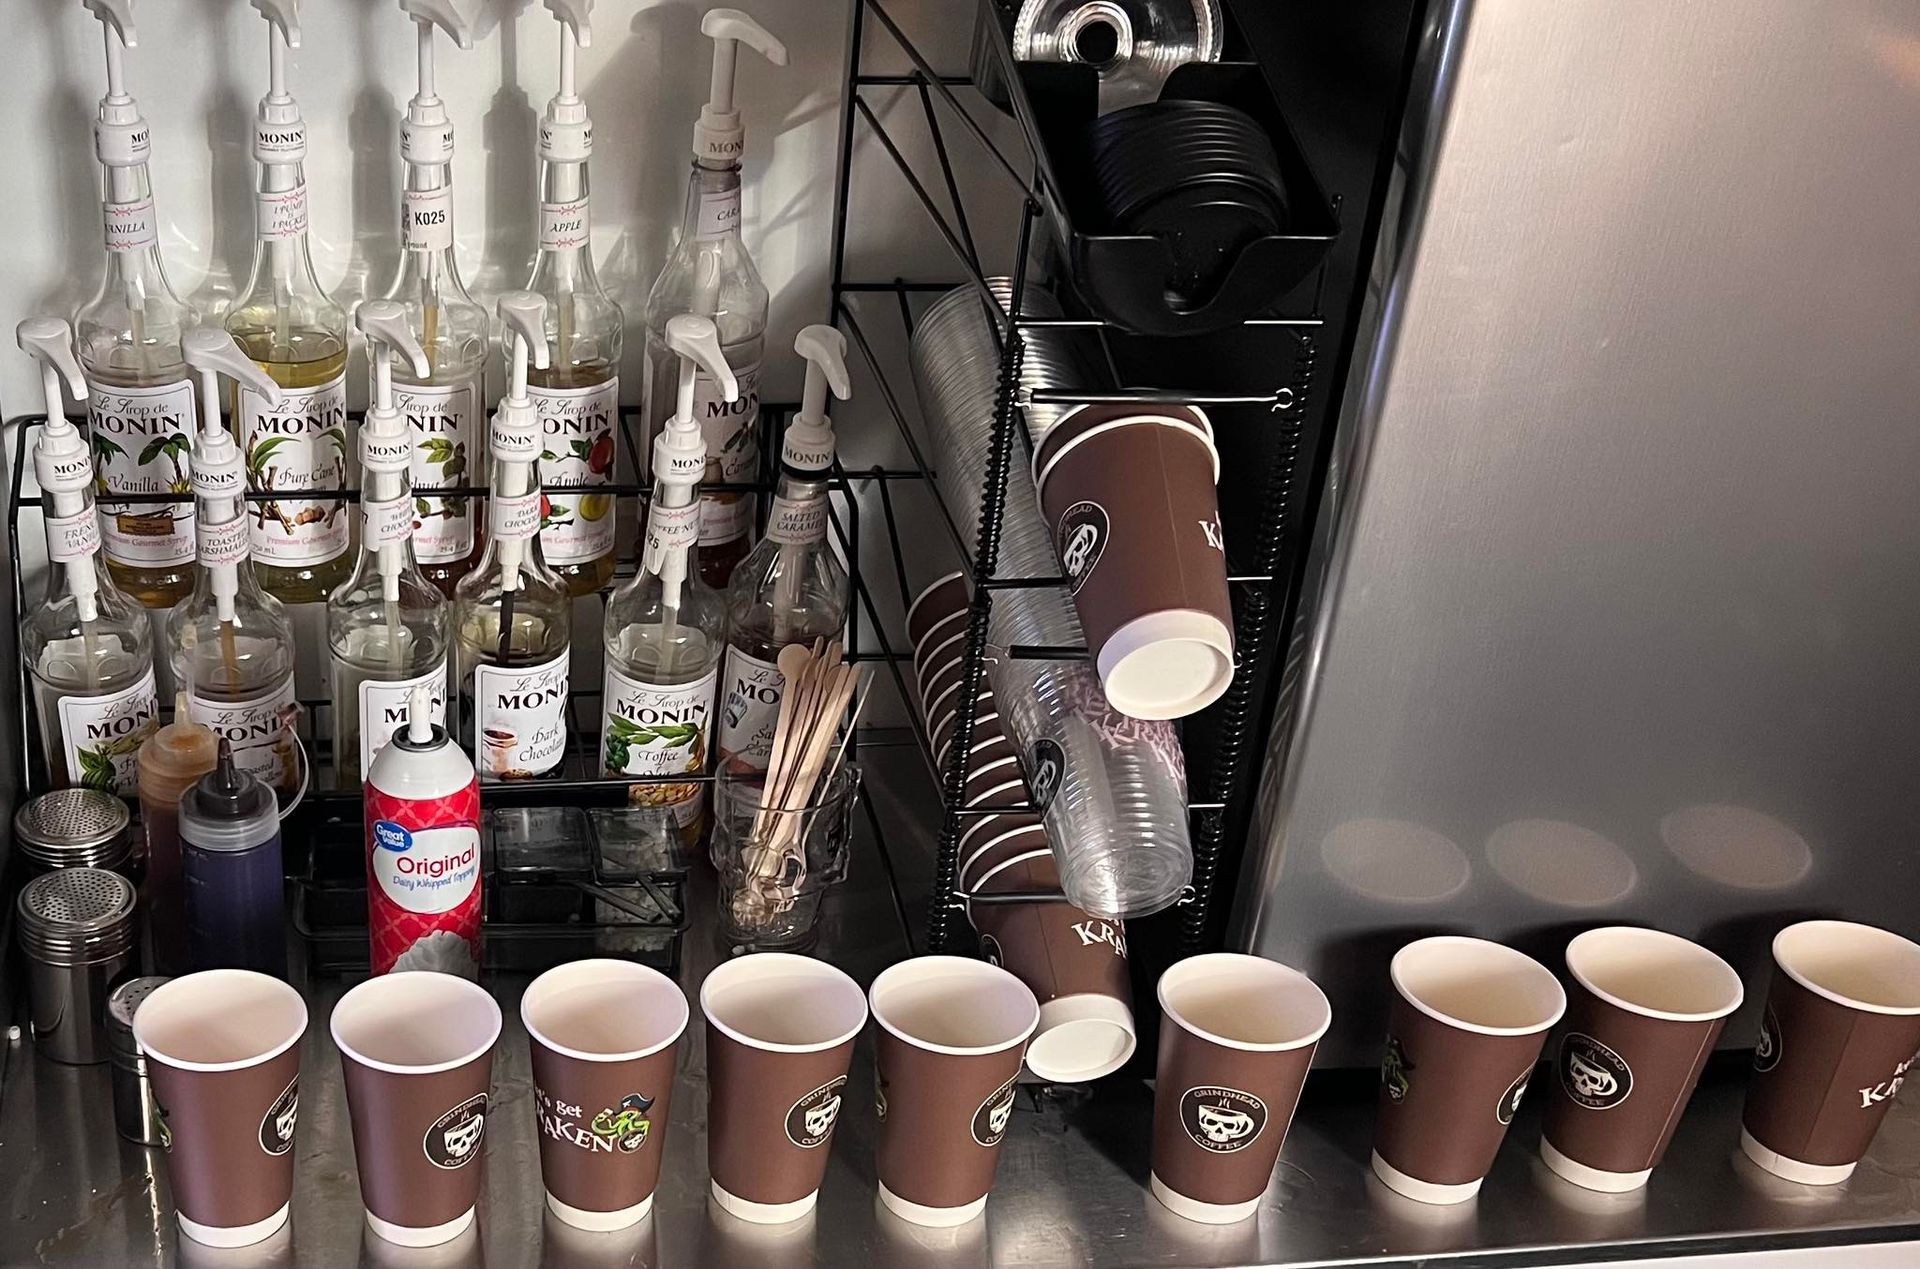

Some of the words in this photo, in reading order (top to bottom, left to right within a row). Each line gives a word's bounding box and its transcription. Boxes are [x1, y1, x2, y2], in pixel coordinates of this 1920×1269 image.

[259, 131, 304, 144] MONIN
[550, 220, 582, 232] APPLE
[89, 407, 180, 435] MONIN
[257, 403, 343, 434] MONIN
[406, 413, 460, 432] NIN
[543, 410, 610, 435] ONIN
[108, 473, 159, 492] Vanilla
[782, 511, 821, 522] SALTED
[616, 698, 707, 725] MONIN
[532, 722, 559, 745] Dark
[638, 750, 679, 764] Toffee
[376, 824, 405, 841] Great
[382, 836, 405, 848] Value
[397, 843, 475, 878] Original
[393, 875, 415, 891] Dairy
[1194, 1089, 1261, 1110] GRINDHEAD
[1194, 1134, 1242, 1150] COFFEE
